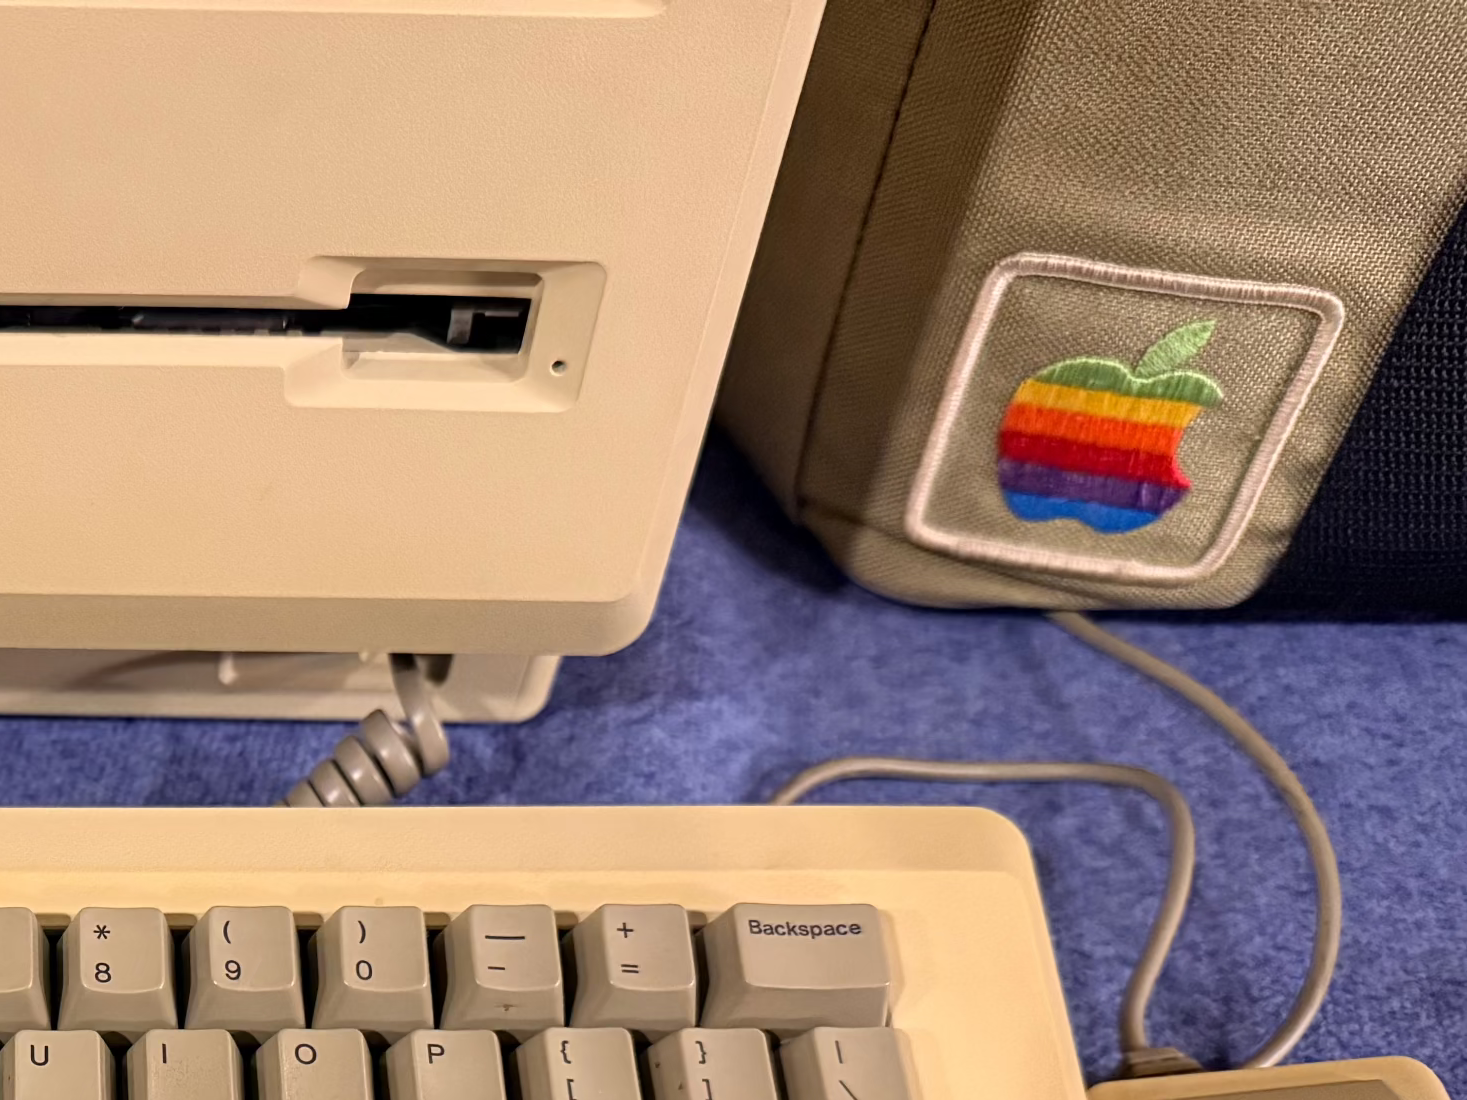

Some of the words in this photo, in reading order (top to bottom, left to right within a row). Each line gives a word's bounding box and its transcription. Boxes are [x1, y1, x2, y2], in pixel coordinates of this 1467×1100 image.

[222, 920, 232, 945] (
[357, 920, 367, 944] )
[616, 922, 635, 939] +
[748, 919, 862, 940] Backspace
[94, 962, 112, 984] 8
[224, 959, 242, 981] 9
[355, 959, 373, 981] 0
[620, 963, 640, 974] =
[30, 1044, 49, 1067] U
[161, 1043, 167, 1064] I
[294, 1043, 317, 1065] O
[427, 1043, 445, 1064] P
[560, 1040, 572, 1065] {
[695, 1040, 707, 1065] }
